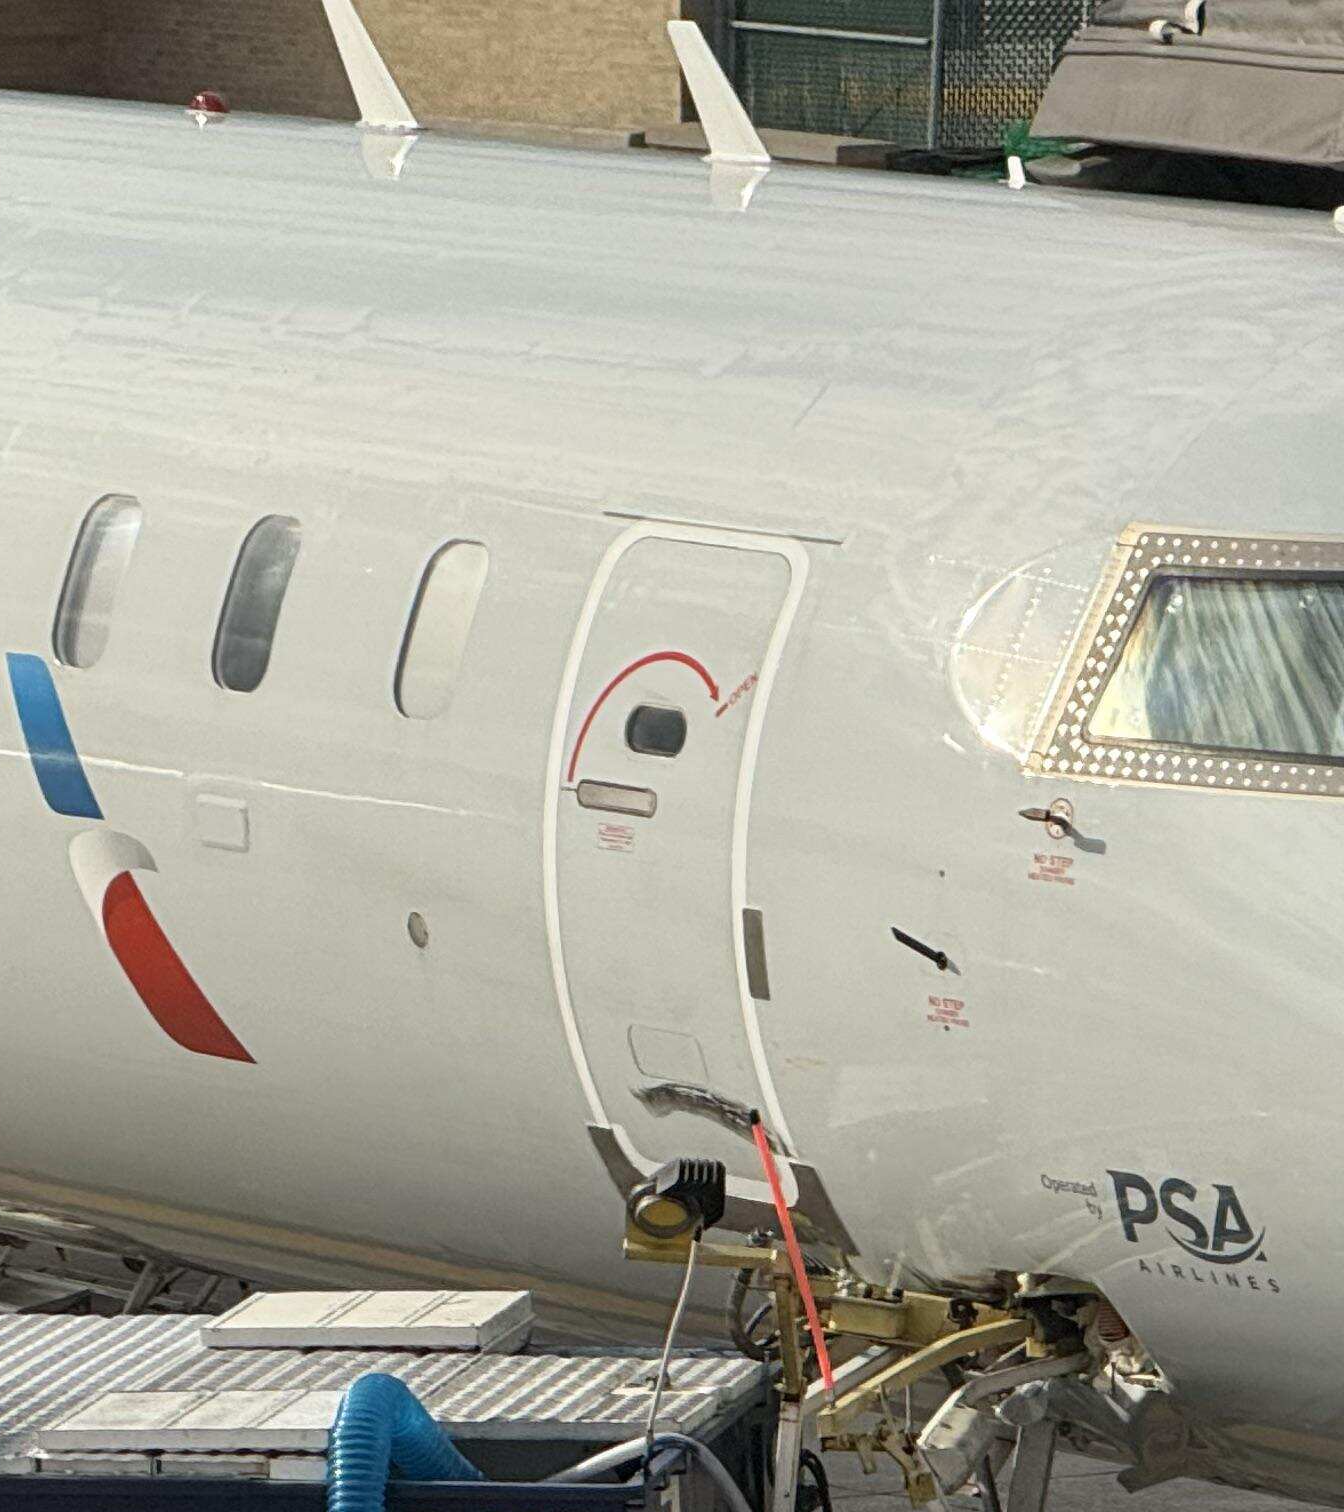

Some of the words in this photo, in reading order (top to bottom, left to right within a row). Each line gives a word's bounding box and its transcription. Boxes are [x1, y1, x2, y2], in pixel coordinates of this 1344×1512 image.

[1040, 1173, 1098, 1197] Operated
[1085, 1199, 1103, 1220] by
[1106, 1169, 1256, 1252] PSA
[1139, 1259, 1281, 1294] AIRLINES
